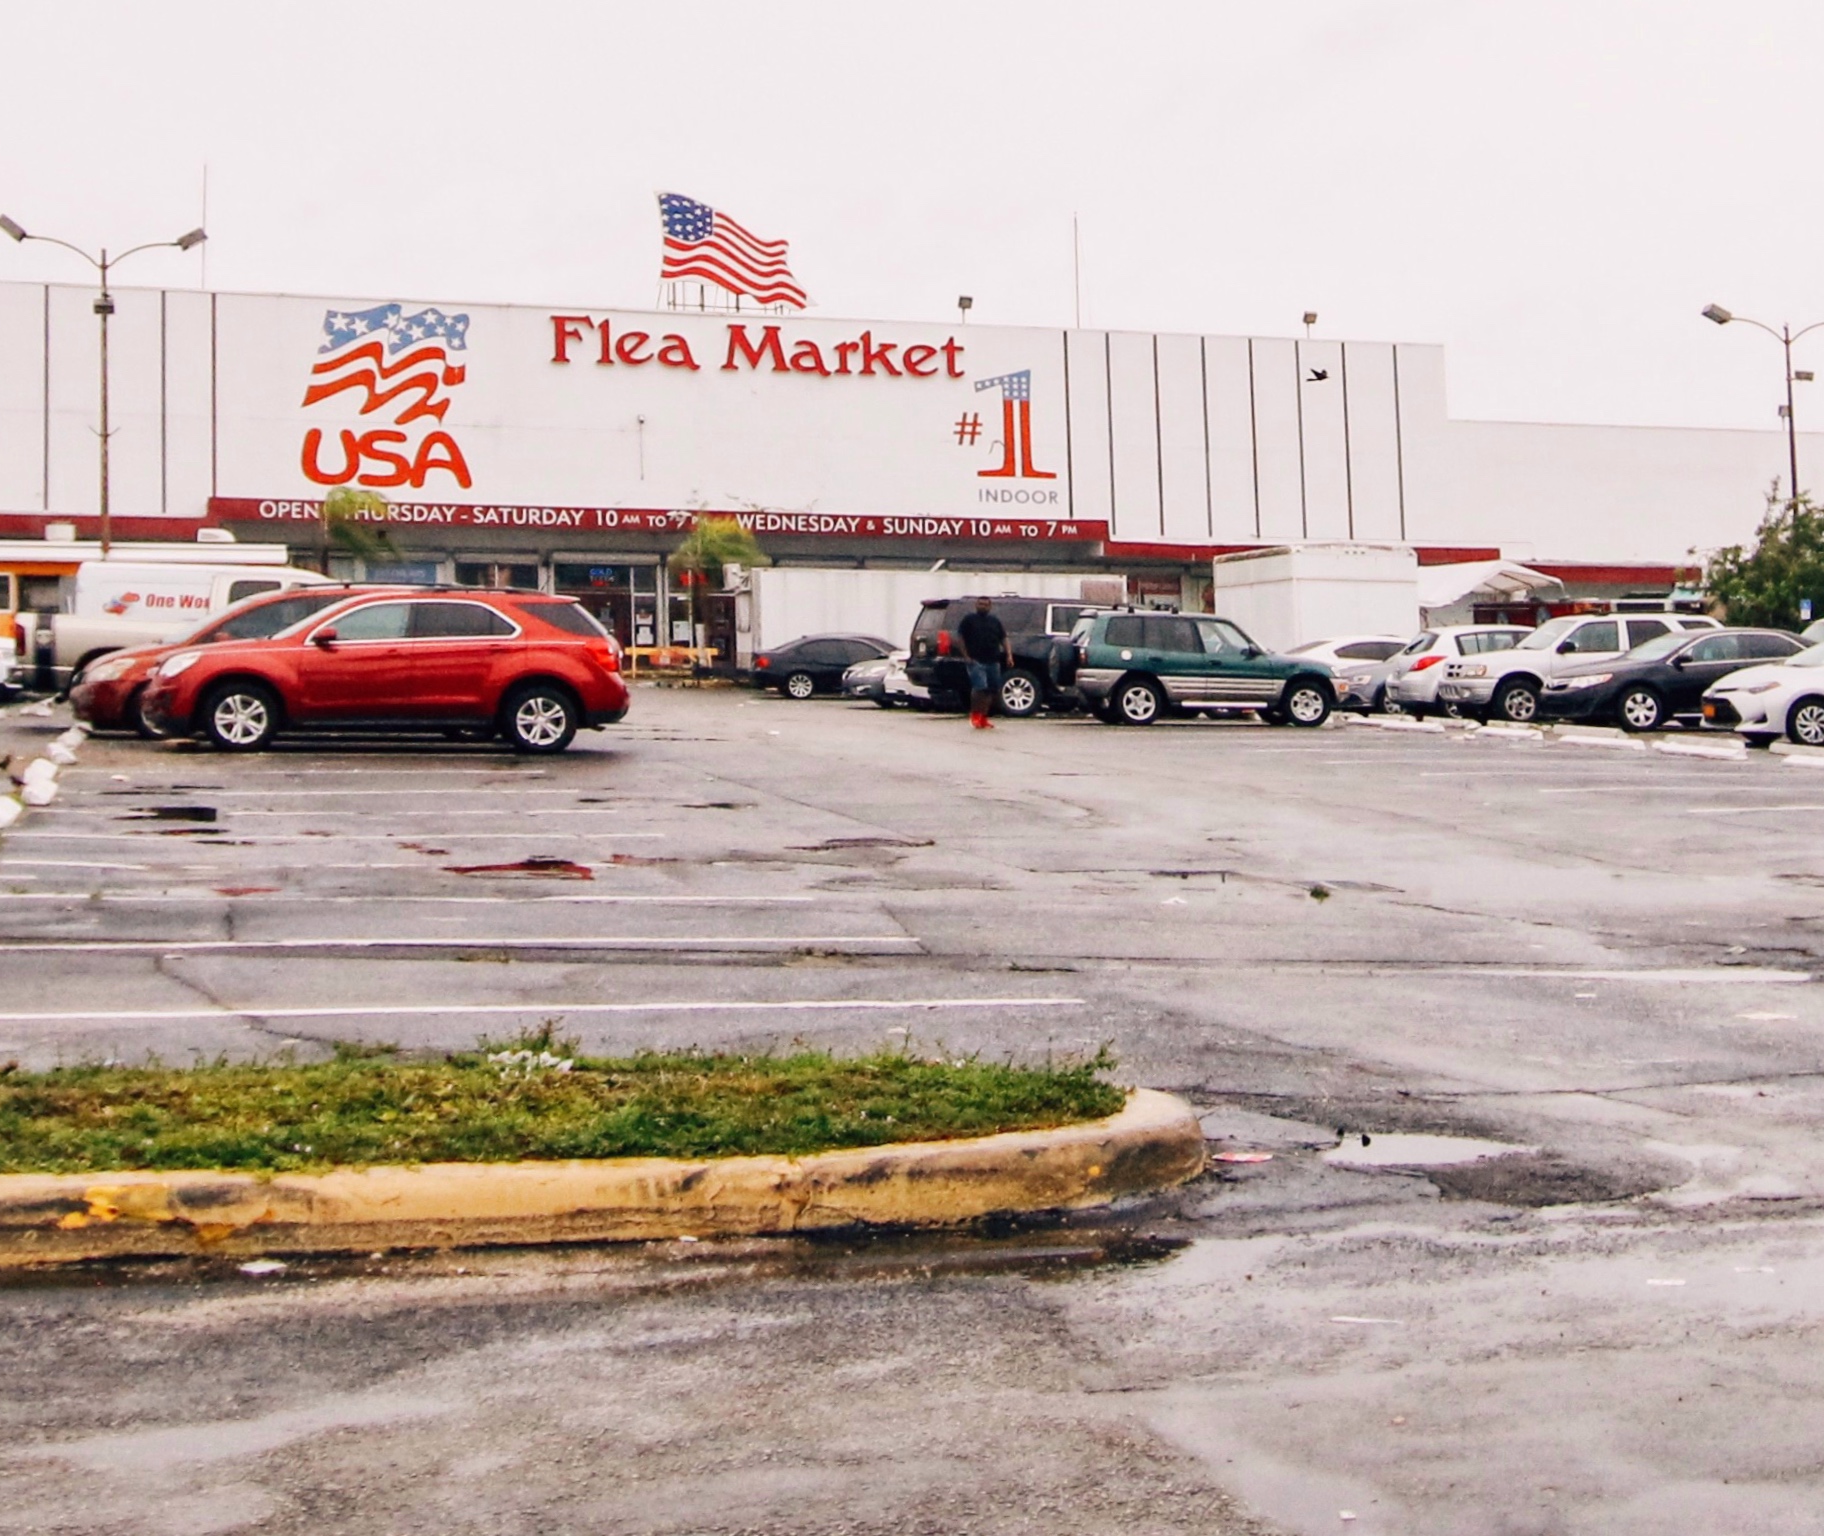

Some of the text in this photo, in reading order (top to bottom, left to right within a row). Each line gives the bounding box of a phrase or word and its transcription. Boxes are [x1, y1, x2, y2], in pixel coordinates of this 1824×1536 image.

[550, 315, 965, 378] Flea Market
[301, 428, 472, 489] USA
[978, 487, 1059, 505] INDOOR
[259, 501, 319, 520] OPEN
[473, 508, 585, 527] SATURDAY
[595, 509, 618, 527] 10
[622, 515, 641, 524] AM
[647, 514, 667, 527] TO
[736, 512, 1077, 538] WEDNESDAY & SUNDAY 10 AM TO 7 PM
[145, 593, 175, 608] One
